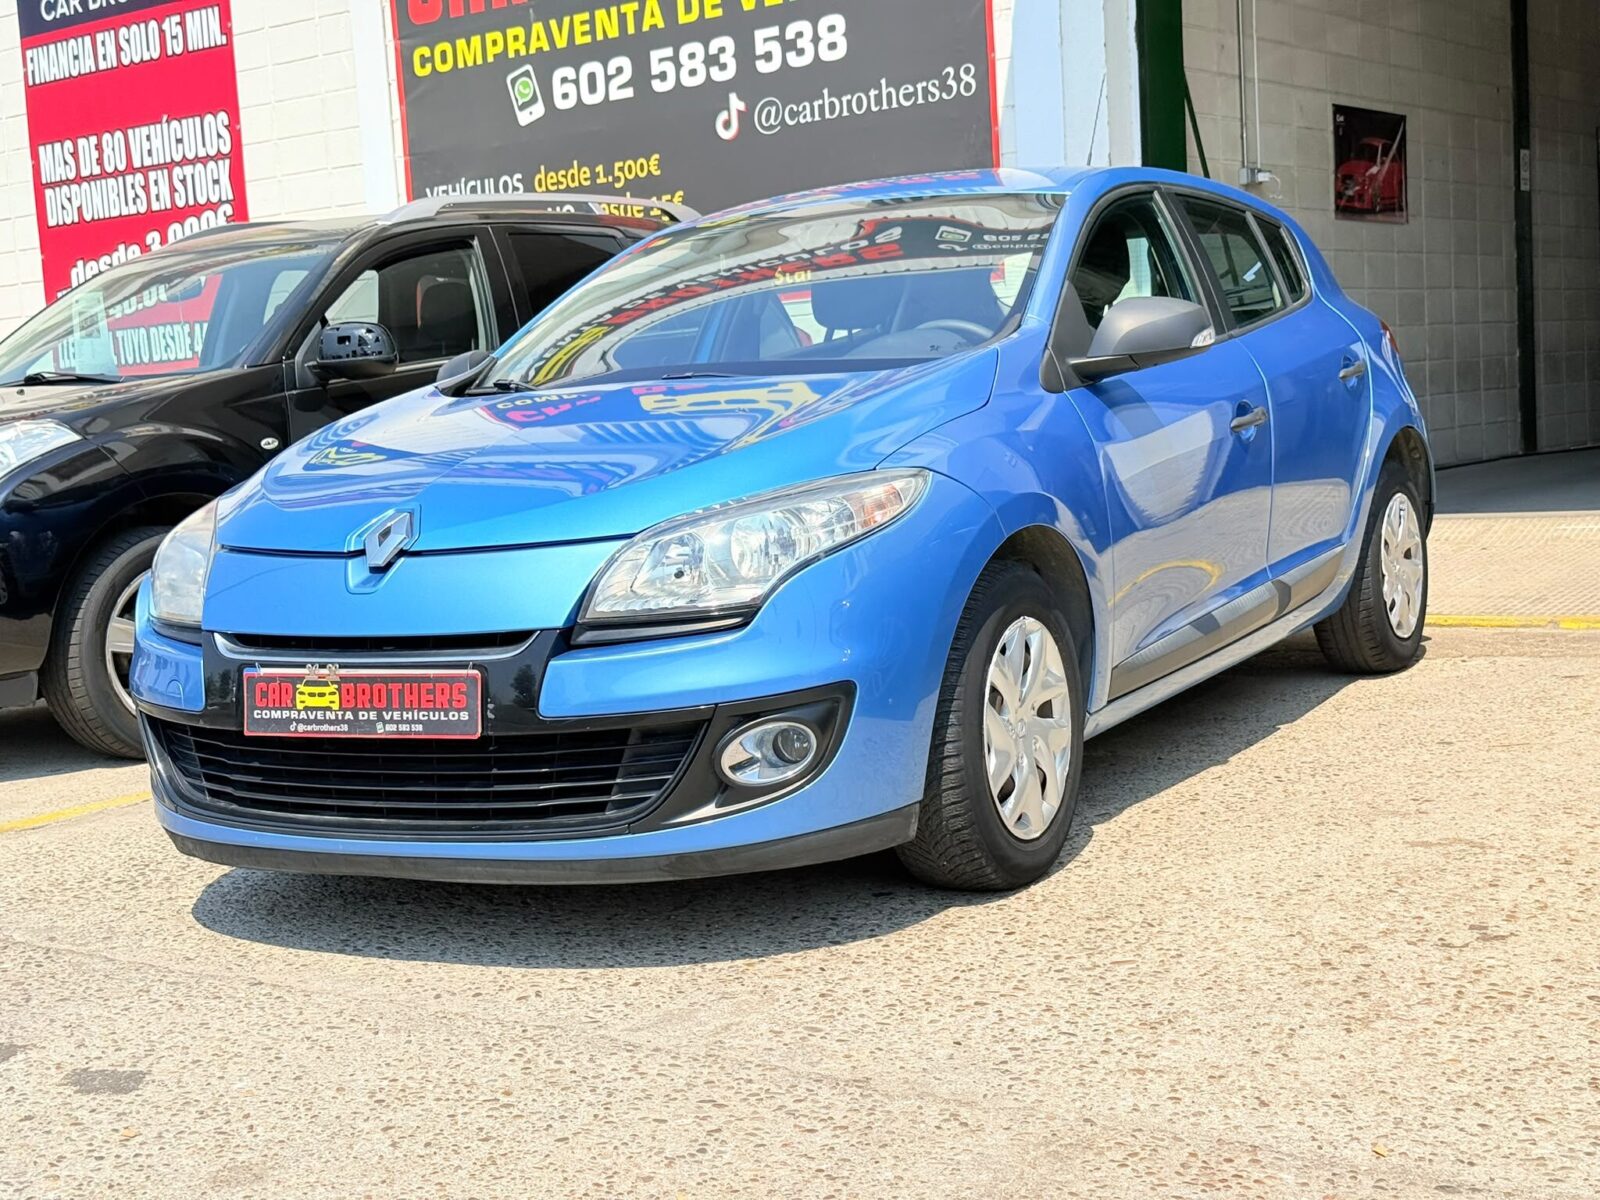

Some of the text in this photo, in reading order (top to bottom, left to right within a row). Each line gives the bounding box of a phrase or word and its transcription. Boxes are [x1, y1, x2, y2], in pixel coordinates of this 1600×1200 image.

[25, 6, 228, 87] FINANCIA EN SOLO 15 MIN.
[413, 0, 665, 77] COMPRAVENTA
[552, 13, 848, 110] 602 583 538
[754, 63, 977, 135] @carbrothers38
[37, 112, 232, 184] MAS DE 80 VEHÍCULOS
[534, 160, 591, 192] desde
[595, 154, 661, 188] 1.500€
[44, 159, 234, 227] DISPONIBLES EN STOCK
[253, 709, 469, 721] COMPRAVENTA DE VEHÍCULOS
[255, 682, 468, 709] CAR BROTHERS
